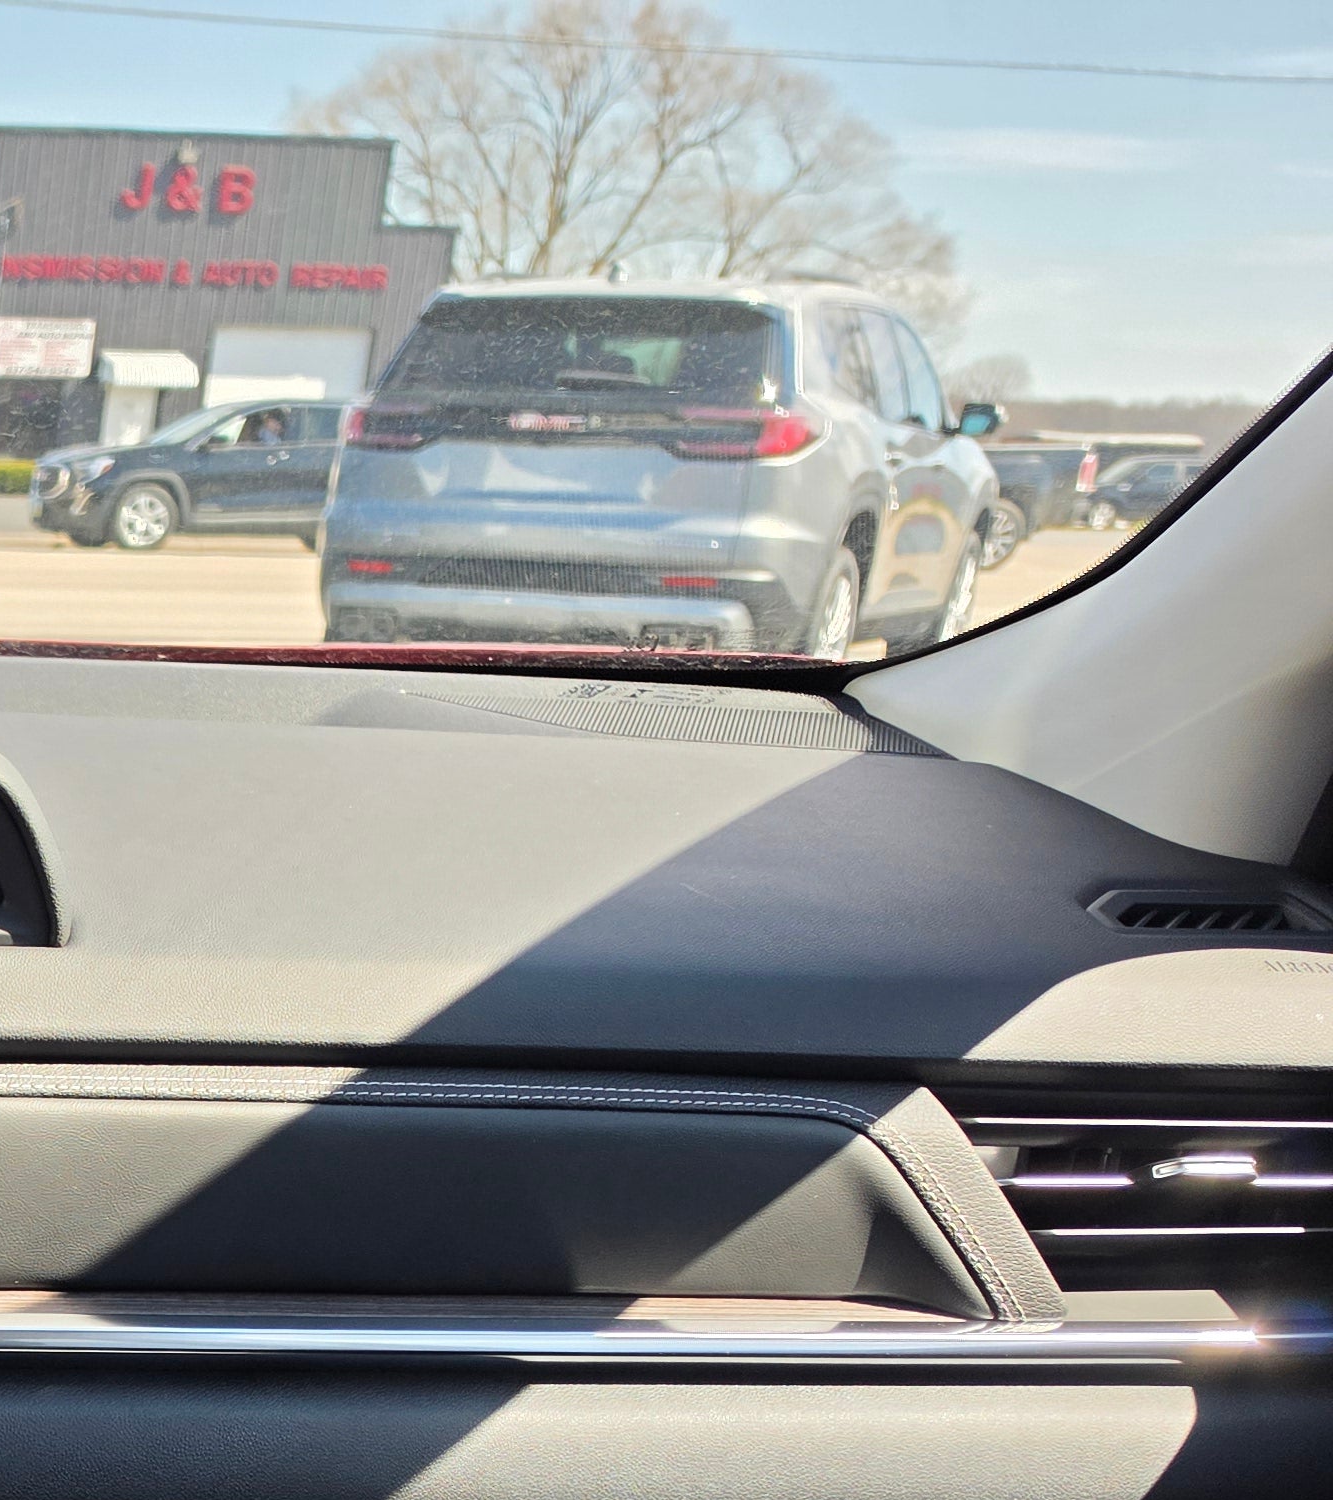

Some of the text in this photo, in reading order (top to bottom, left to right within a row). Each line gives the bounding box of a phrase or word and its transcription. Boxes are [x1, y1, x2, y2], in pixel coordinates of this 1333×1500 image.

[120, 163, 257, 216] J & B
[202, 259, 280, 288] AUTO
[290, 262, 390, 290] REPAIR
